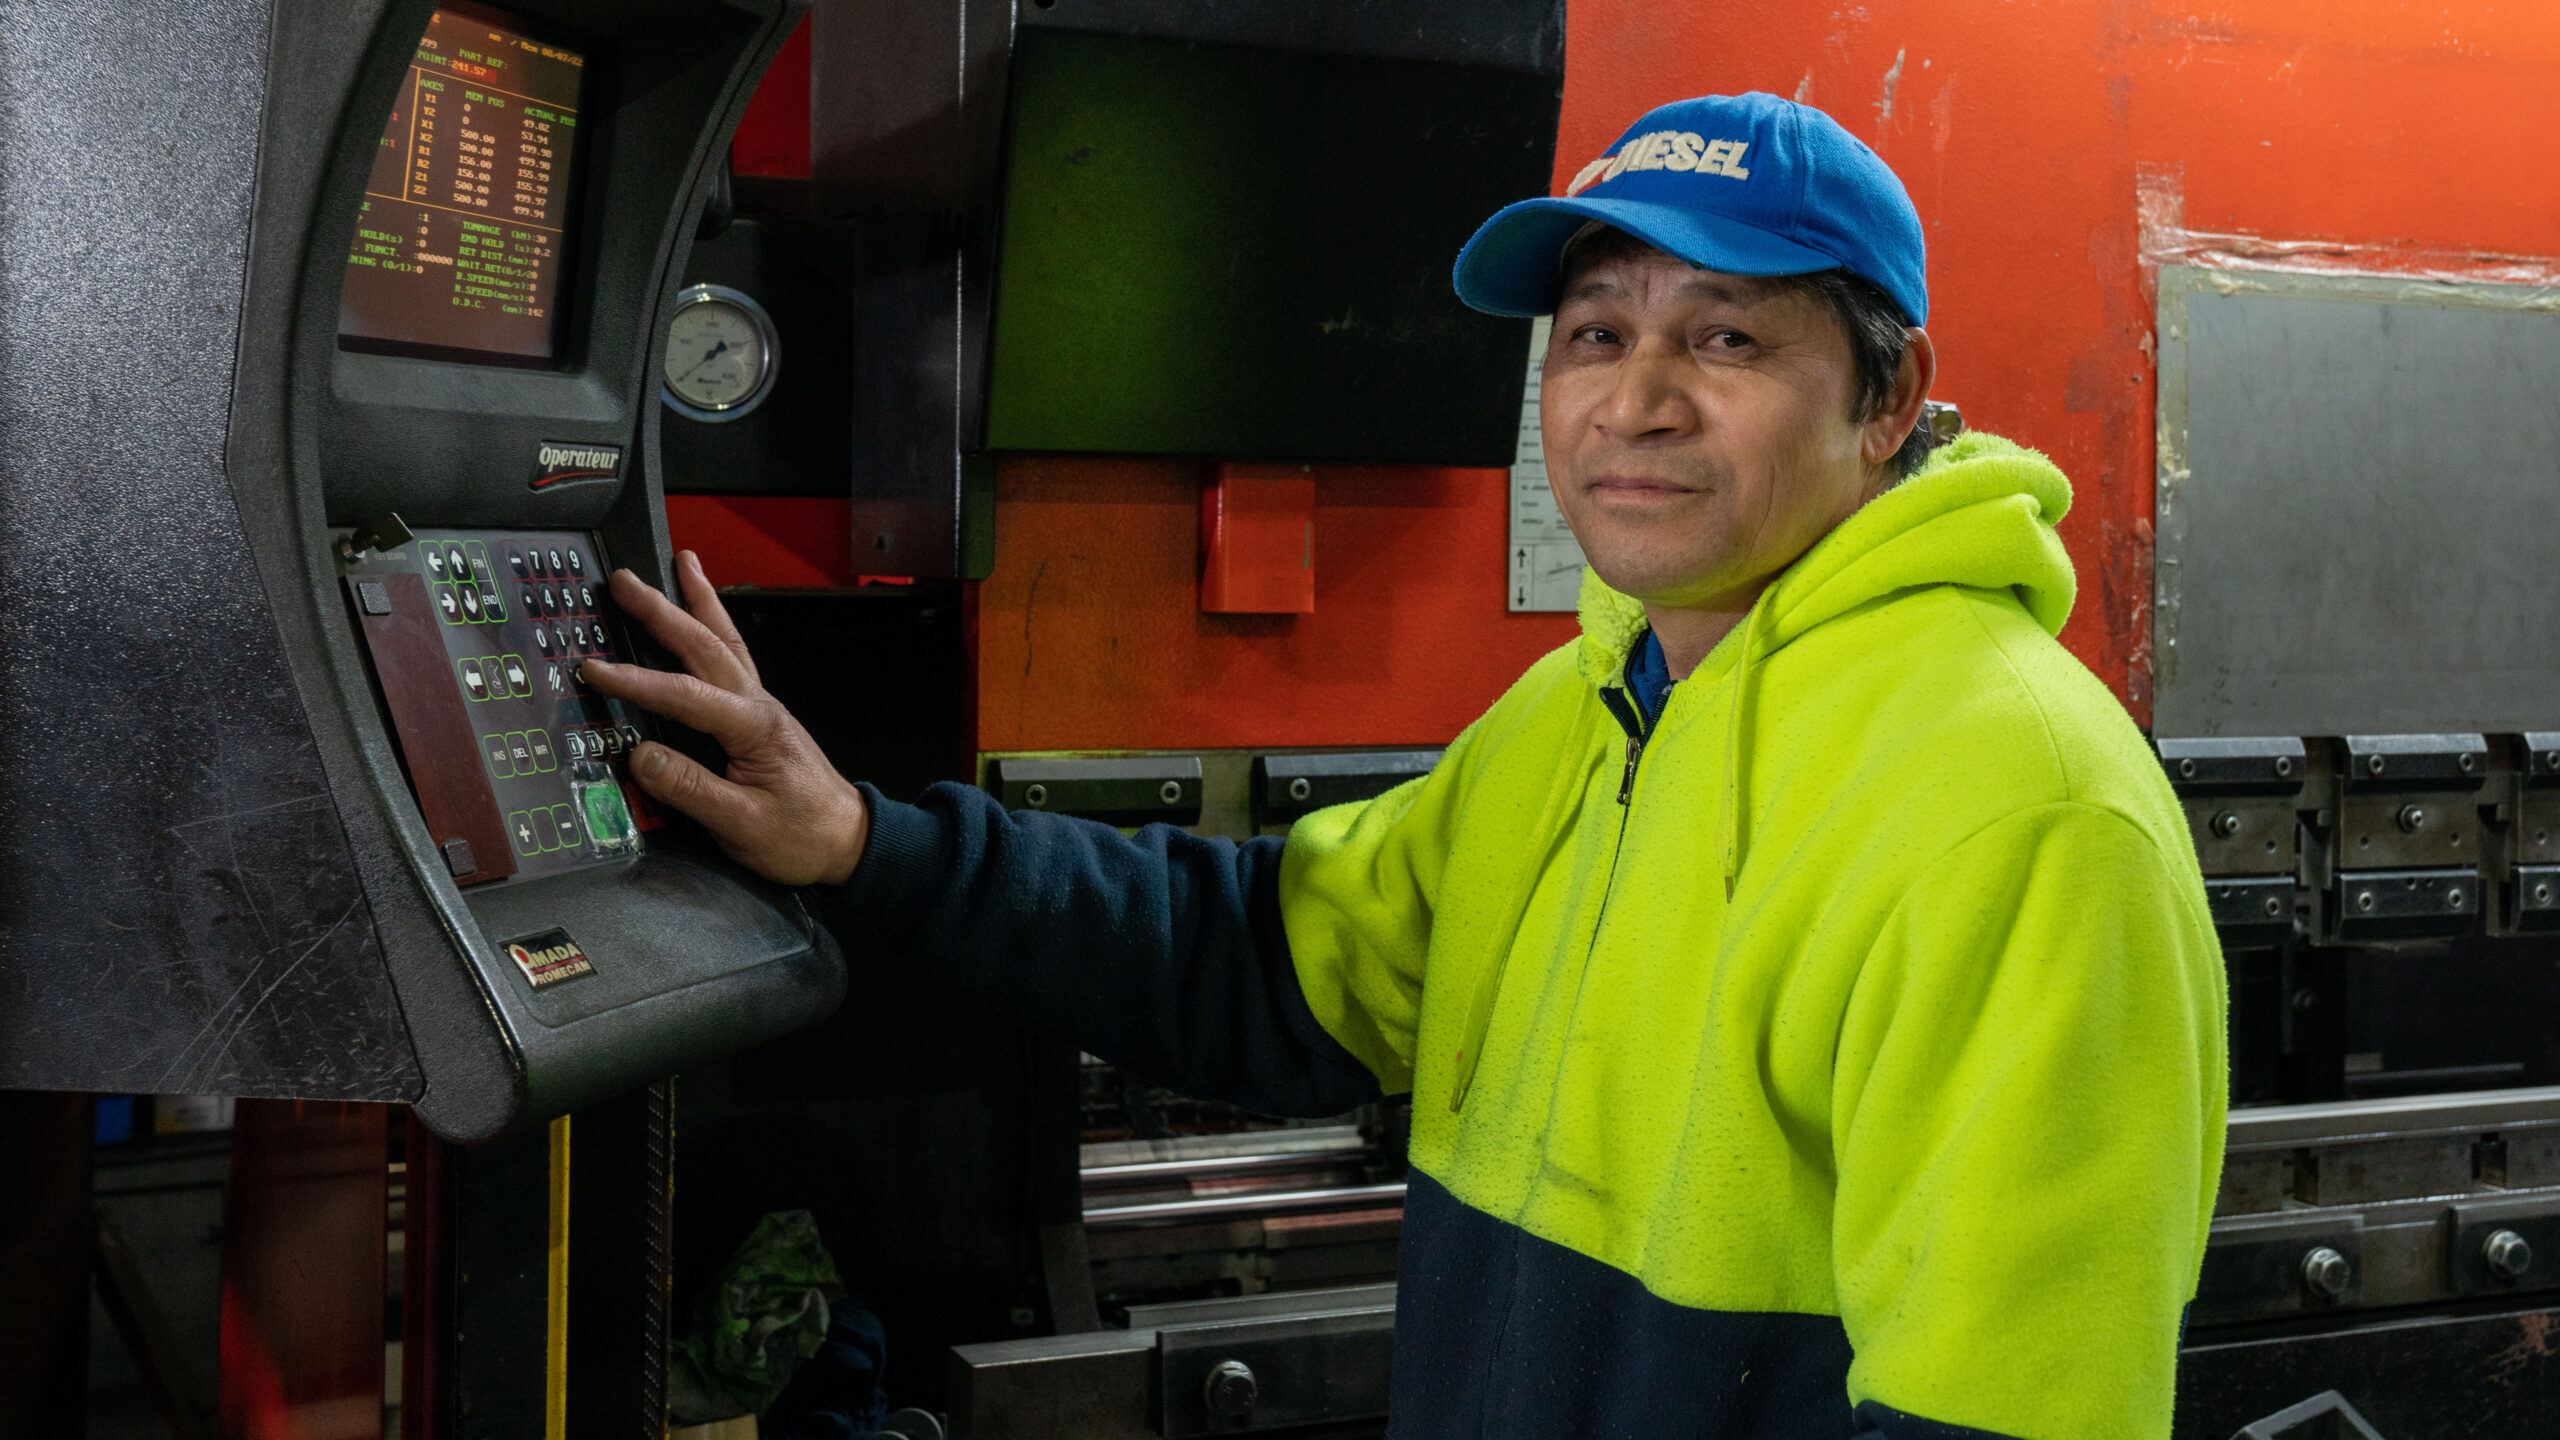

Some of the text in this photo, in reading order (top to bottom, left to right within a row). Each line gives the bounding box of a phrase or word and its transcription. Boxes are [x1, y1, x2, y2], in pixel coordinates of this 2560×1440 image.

[459, 49, 481, 62] PART
[420, 79, 576, 127] AXES MEM POS ACTUAL POS
[1602, 130, 1749, 182] DIESEL
[462, 221, 502, 236] TONNAGE
[460, 233, 478, 244] END
[482, 237, 504, 249] HOLD
[459, 246, 477, 257] RET
[539, 446, 619, 472] Operateur
[472, 558, 484, 569] FIN
[530, 550, 580, 570] 7 8 9
[482, 594, 498, 605] END
[544, 587, 592, 608] 4 5 6
[536, 626, 605, 648] 0 1 2 3
[493, 750, 506, 761] INS
[512, 747, 528, 759] DEL
[531, 960, 592, 985] PROMECAM
